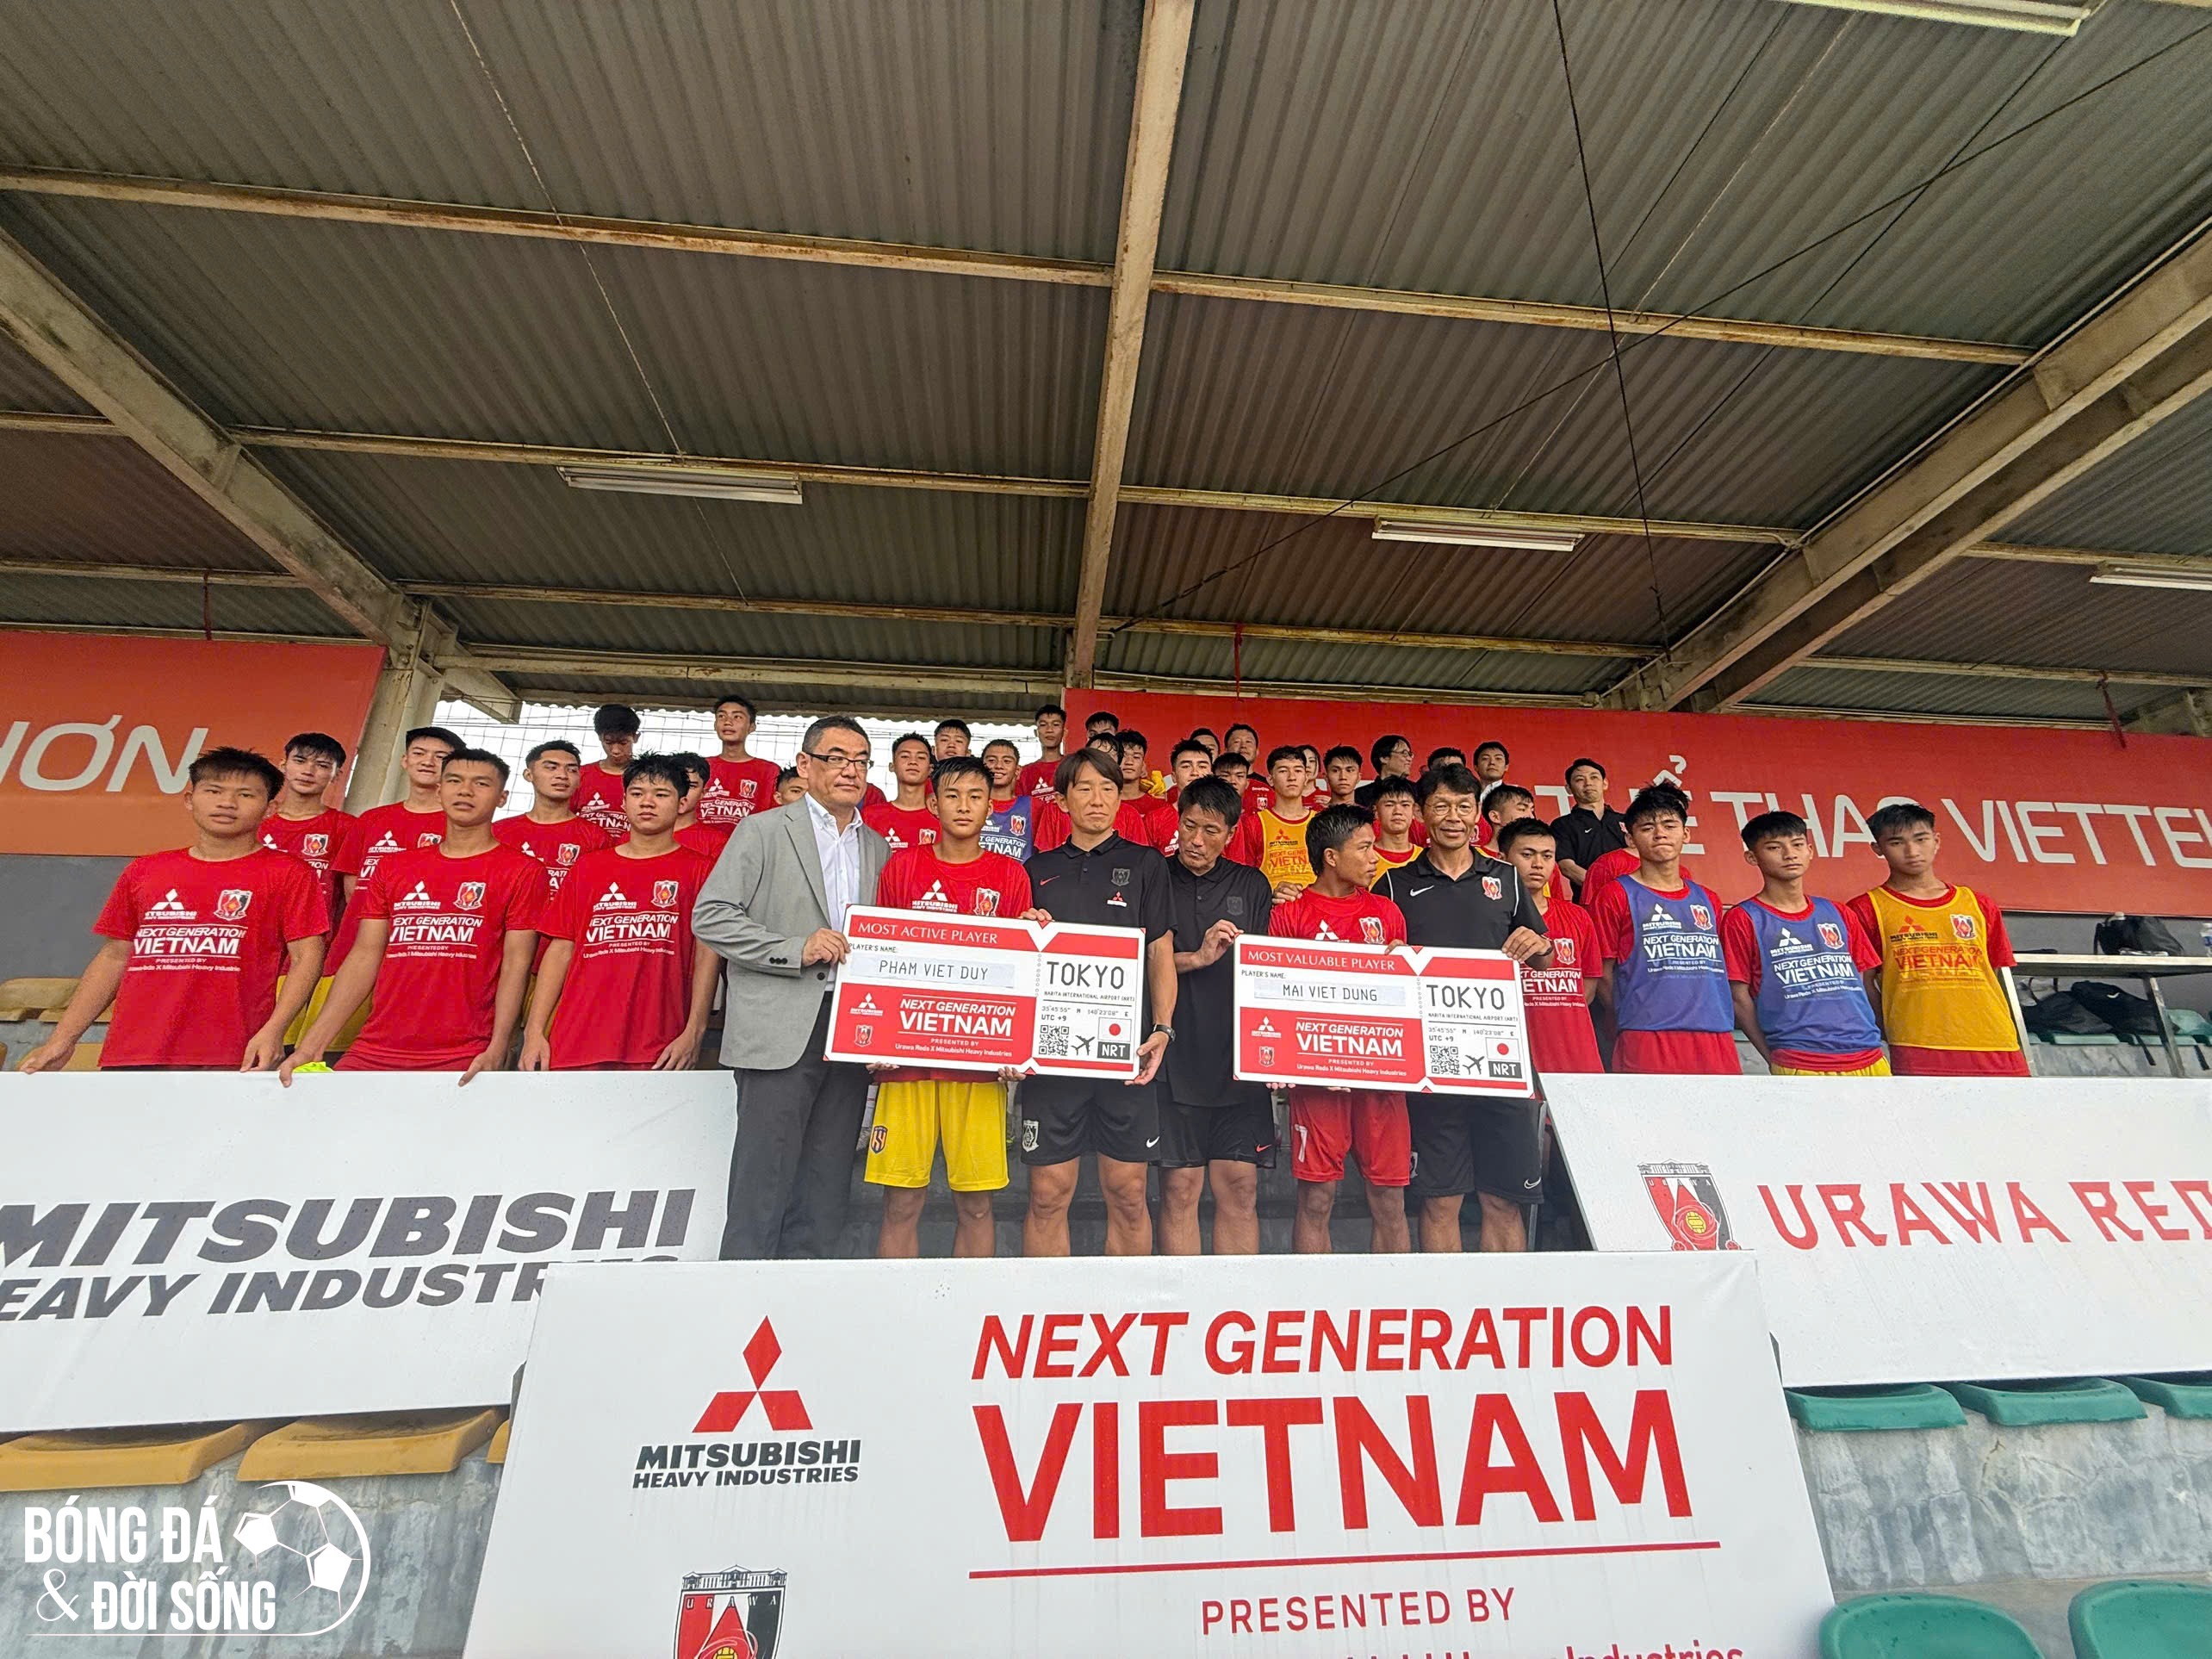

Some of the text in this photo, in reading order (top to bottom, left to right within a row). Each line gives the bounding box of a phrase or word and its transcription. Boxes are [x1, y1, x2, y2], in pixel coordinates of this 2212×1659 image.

[0, 715, 208, 793] ƠN
[1270, 855, 1307, 867] VIETN
[416, 916, 482, 927] GENERATION
[614, 914, 678, 924] GENERATION
[135, 927, 247, 939] NEXT GENERATION
[586, 923, 671, 943] VIETNAM
[857, 923, 997, 944] MOST ACTIVE PLAYER
[1643, 935, 1669, 945] NEXT
[134, 936, 239, 955] VIETNAM
[1644, 943, 1717, 959] VIETNAM
[1893, 946, 1982, 956] NEXT GENERAON
[879, 960, 988, 980] PHAM VIET DUY
[1247, 950, 1395, 971] MOST VALUABLE PLAYER
[1774, 960, 1799, 972] NEXT
[1047, 961, 1124, 990] TOKYO
[1241, 969, 1270, 978] PLAYER'S
[1776, 963, 1855, 985] VIETNAM
[1283, 984, 1378, 1002] MAI VIET DUNG
[1426, 984, 1505, 1010] TOKYO
[900, 998, 1016, 1016] NEXT GENERATION
[899, 1010, 1012, 1037] VIETNAM
[1296, 1022, 1404, 1038] NEXT GENERATION
[935, 1046, 965, 1054] Mitsubishi
[965, 1047, 984, 1057] Heavy
[984, 1048, 1013, 1057] Industries
[1102, 1044, 1126, 1057] NRT
[1296, 1033, 1403, 1057] VIETNAM
[1362, 1067, 1380, 1076] Heavy
[1493, 1063, 1516, 1076] NRT
[1757, 1182, 2071, 1251] URAWA
[0, 1189, 695, 1269] MITSUBISHI
[207, 1255, 679, 1314] INDUSTR
[972, 1305, 1672, 1380] NEXT GENERATION
[636, 1439, 861, 1469] MITSUBISHI
[972, 1389, 1693, 1543] VIETNAM
[633, 1466, 859, 1488] HEAVY INDUSTRIES
[686, 1594, 777, 1610] URAWA
[1202, 1587, 1514, 1636] PRESENTED BY
